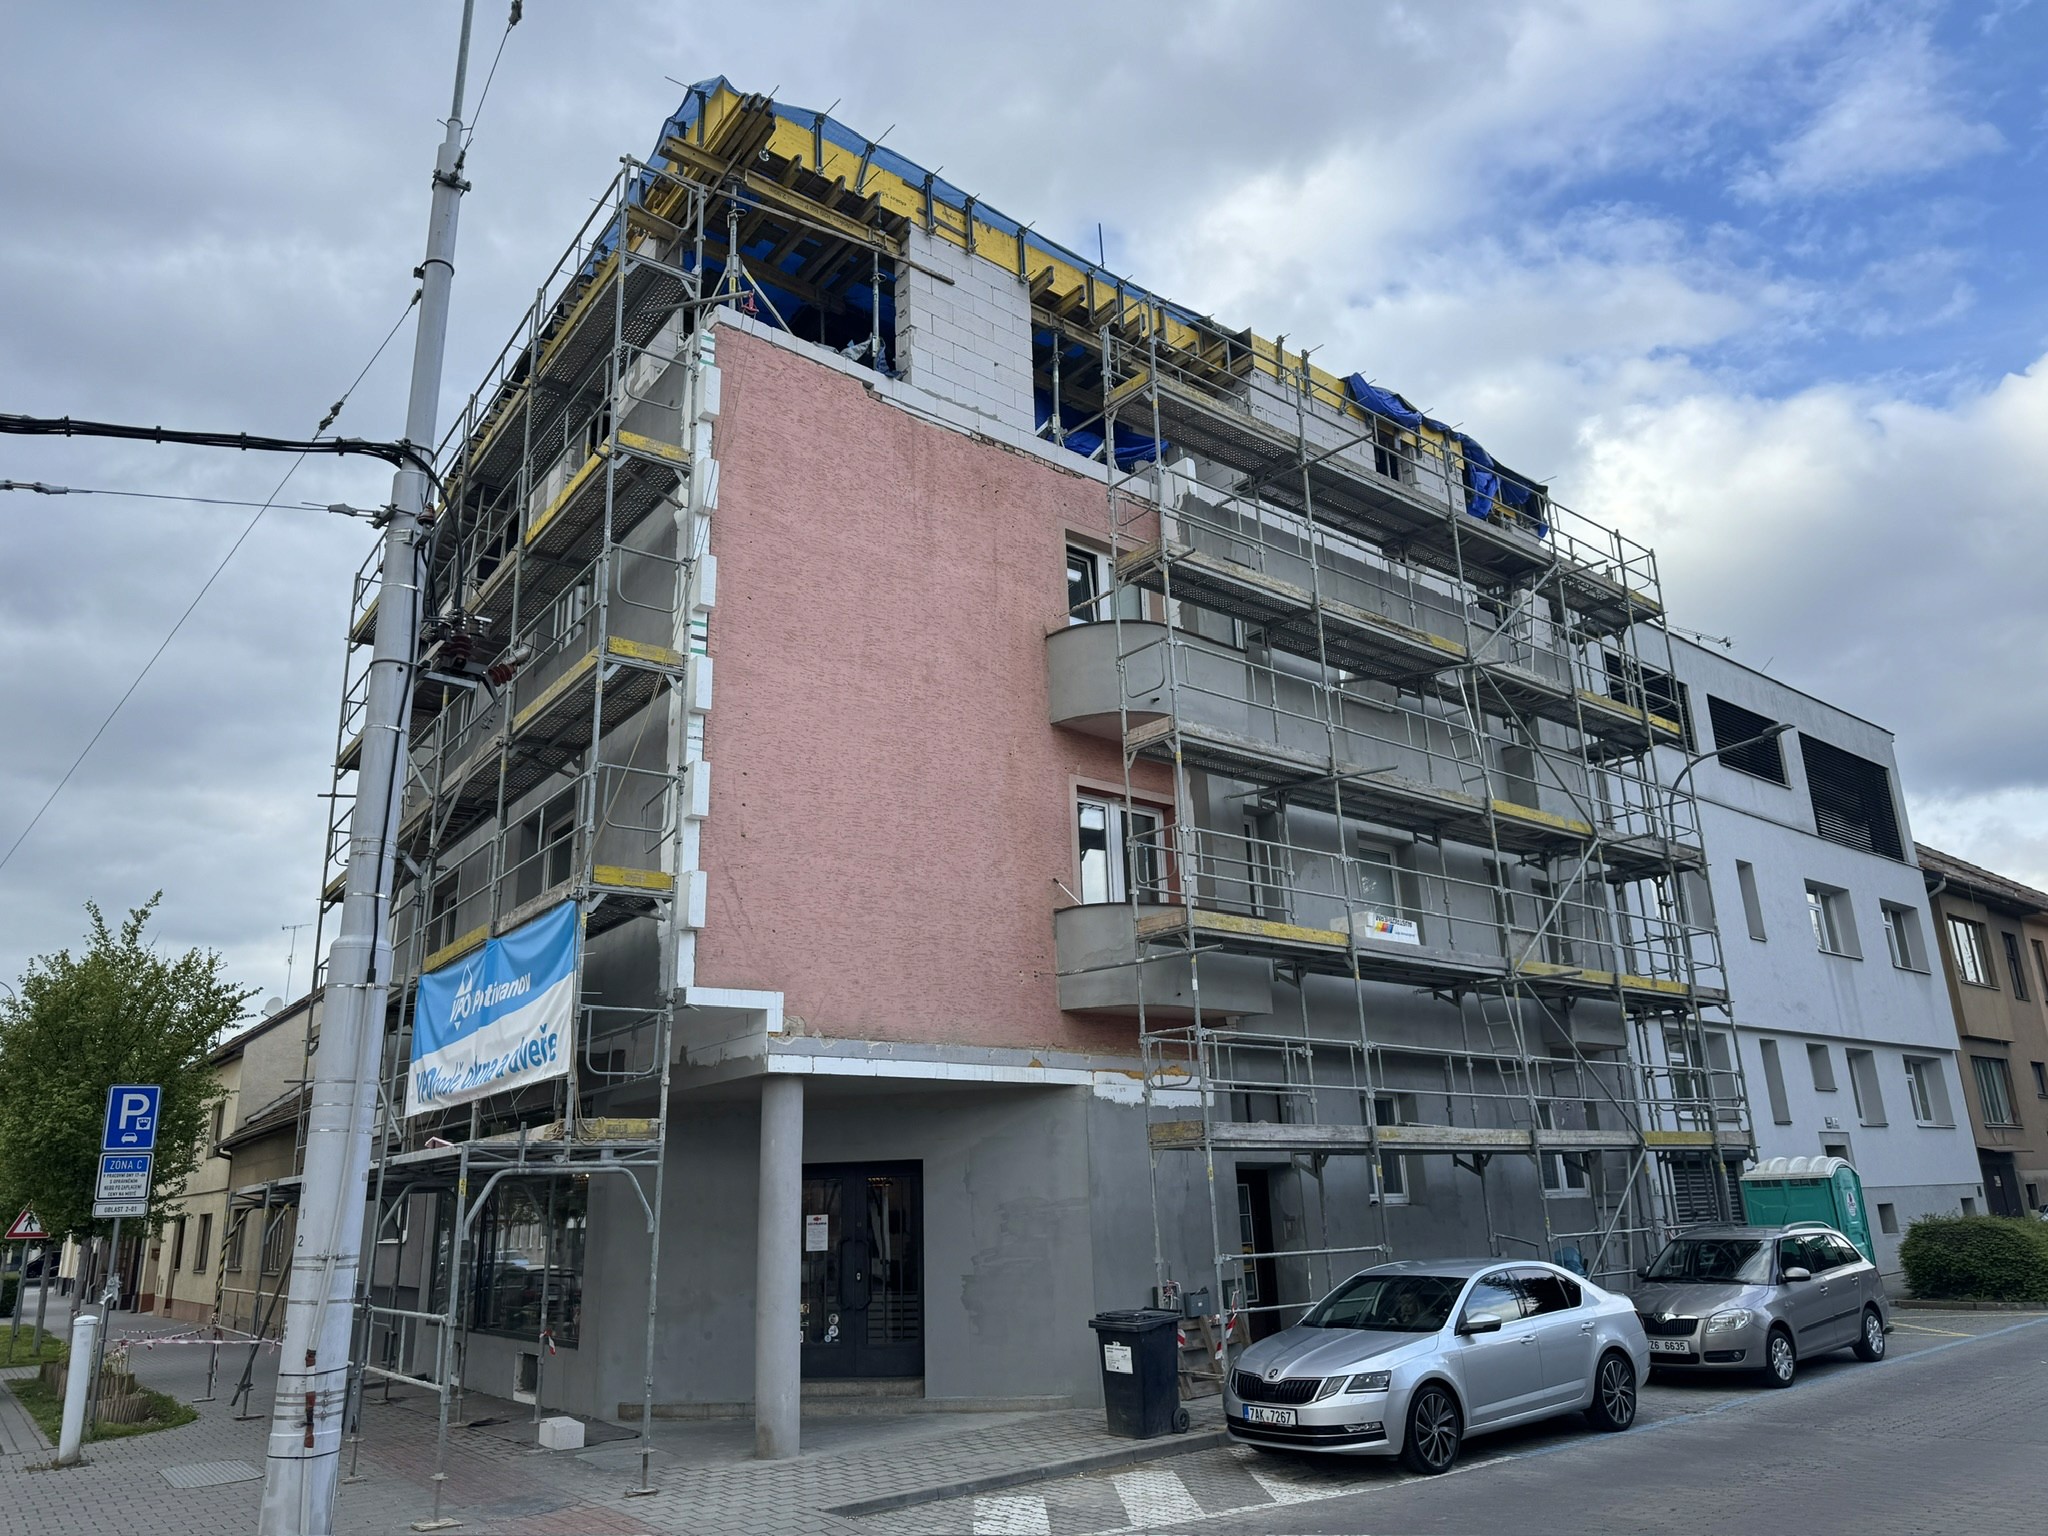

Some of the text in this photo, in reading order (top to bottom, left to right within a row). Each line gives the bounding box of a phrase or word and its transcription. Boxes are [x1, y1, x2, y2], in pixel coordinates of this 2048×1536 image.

[450, 972, 531, 1022] VPO Prtivanov
[461, 1055, 499, 1090] okna
[496, 1053, 510, 1078] a
[508, 1023, 558, 1073] dveře
[119, 1093, 150, 1129] P
[110, 1159, 142, 1169] ZÓNA C
[297, 1234, 304, 1247] 2
[1649, 1340, 1685, 1351] Z6 6635
[1250, 1408, 1291, 1424] 7AK 7267
